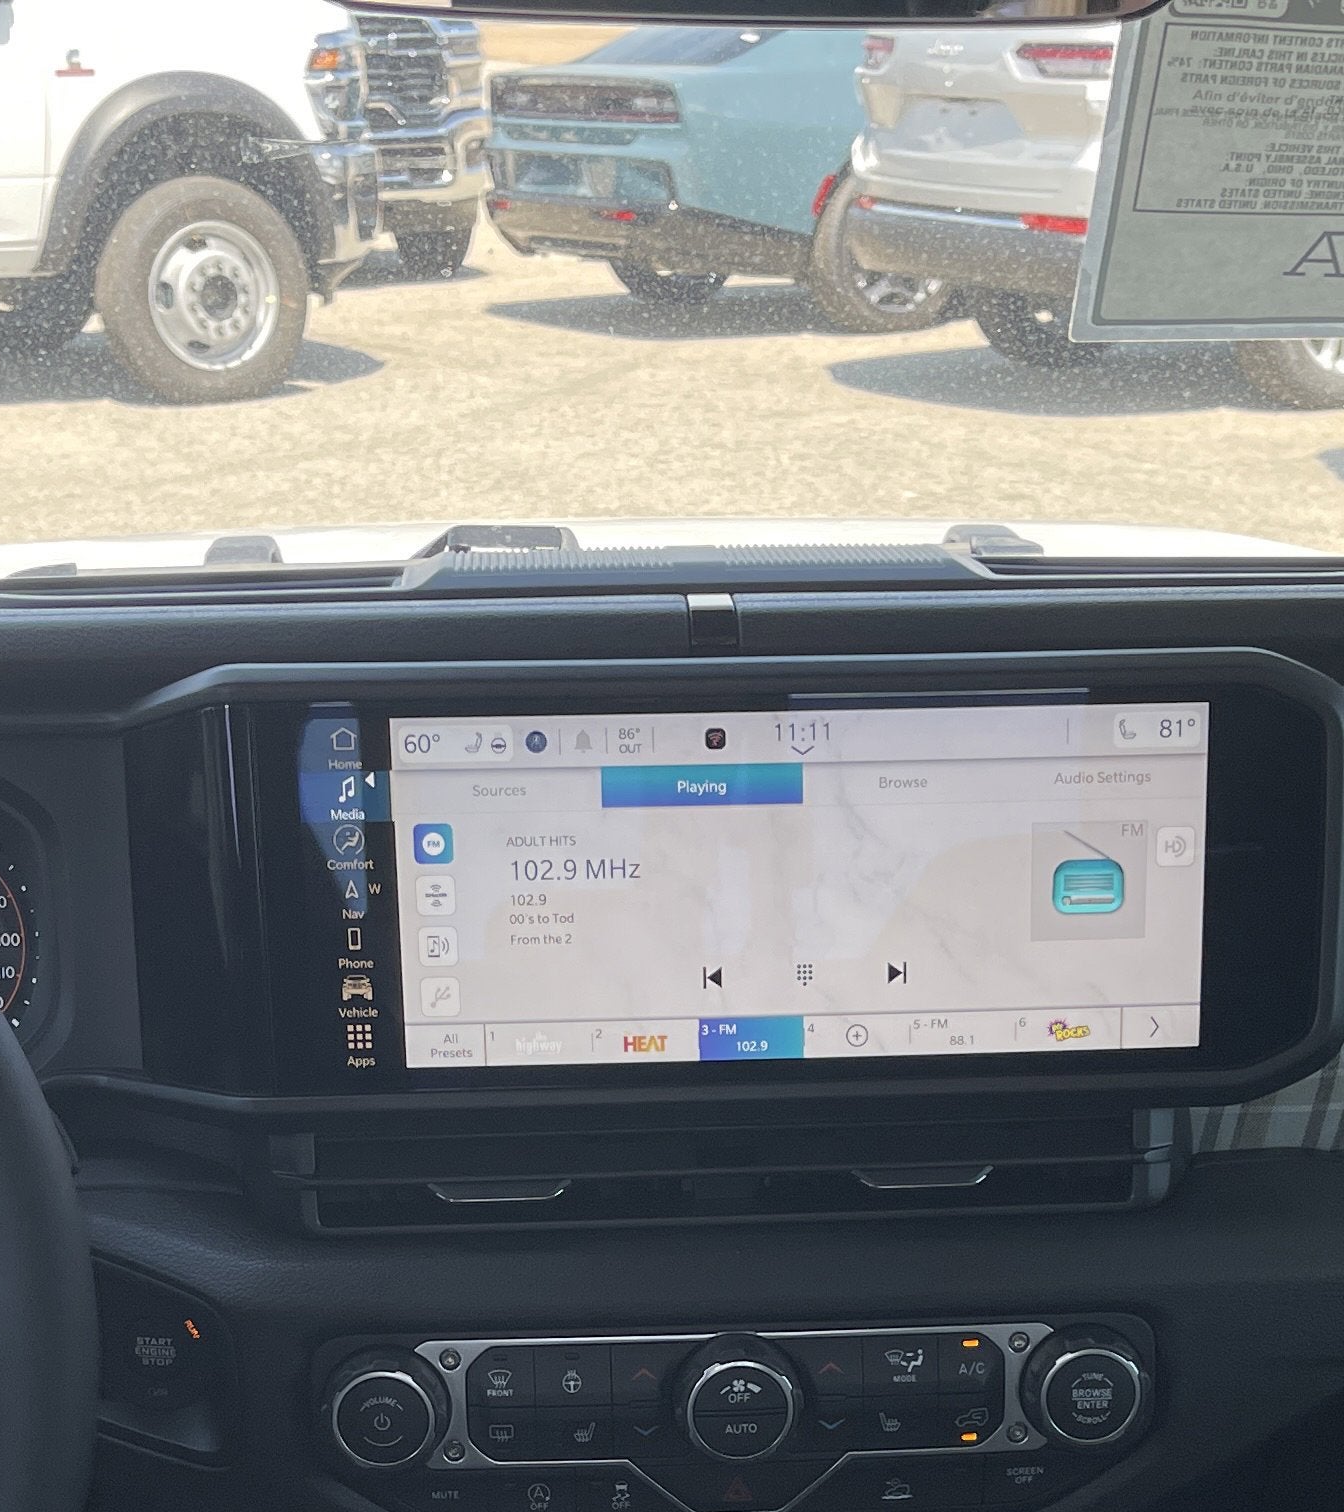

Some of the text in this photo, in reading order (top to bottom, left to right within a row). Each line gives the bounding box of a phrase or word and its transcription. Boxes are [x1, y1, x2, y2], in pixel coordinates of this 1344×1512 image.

[774, 723, 831, 741] 11:11
[619, 743, 642, 754] OUT
[328, 760, 362, 769] Home
[879, 776, 927, 789] Browse
[1054, 770, 1151, 785] Audio Settings
[473, 784, 526, 797] Sources
[677, 781, 727, 796] Playing
[331, 809, 365, 821] Media
[1121, 824, 1144, 837] FM
[507, 835, 576, 848] ADULT HITS
[327, 859, 373, 870] Comfort
[511, 859, 641, 881] 102.9 MHz
[369, 884, 380, 894] W
[510, 894, 546, 906] 102.9
[342, 909, 364, 920] Nav
[537, 914, 549, 924] to
[552, 912, 574, 924] Tod
[510, 934, 572, 946] From the 2
[339, 958, 373, 969] Phone
[339, 1007, 378, 1018] Vehicle
[931, 1019, 948, 1029] FM
[1019, 1018, 1026, 1027] 6
[595, 1029, 602, 1038] 2
[720, 1024, 736, 1035] FM
[808, 1024, 815, 1033] 4
[444, 1033, 458, 1044] All
[950, 1035, 974, 1046] 88.1
[624, 1036, 667, 1053] HEAT
[736, 1040, 768, 1052] 102.9
[430, 1046, 473, 1059] Presets
[348, 1056, 376, 1068] Apps
[137, 1337, 173, 1345] START
[135, 1347, 176, 1356] ENGINE
[959, 1363, 985, 1375] A/C
[893, 1374, 916, 1382] MODE
[487, 1389, 513, 1397] FRONT
[728, 1393, 751, 1404] OFF
[1072, 1388, 1112, 1398] BROWSE
[364, 1396, 398, 1409] VOLUME
[1077, 1400, 1108, 1409] ENTER
[726, 1423, 757, 1434] AUTO
[1007, 1467, 1044, 1476] SCREEN
[1015, 1476, 1032, 1484] OFF
[432, 1491, 459, 1499] MUTE
[530, 1502, 548, 1511] OFF
[612, 1501, 630, 1510] OFF
